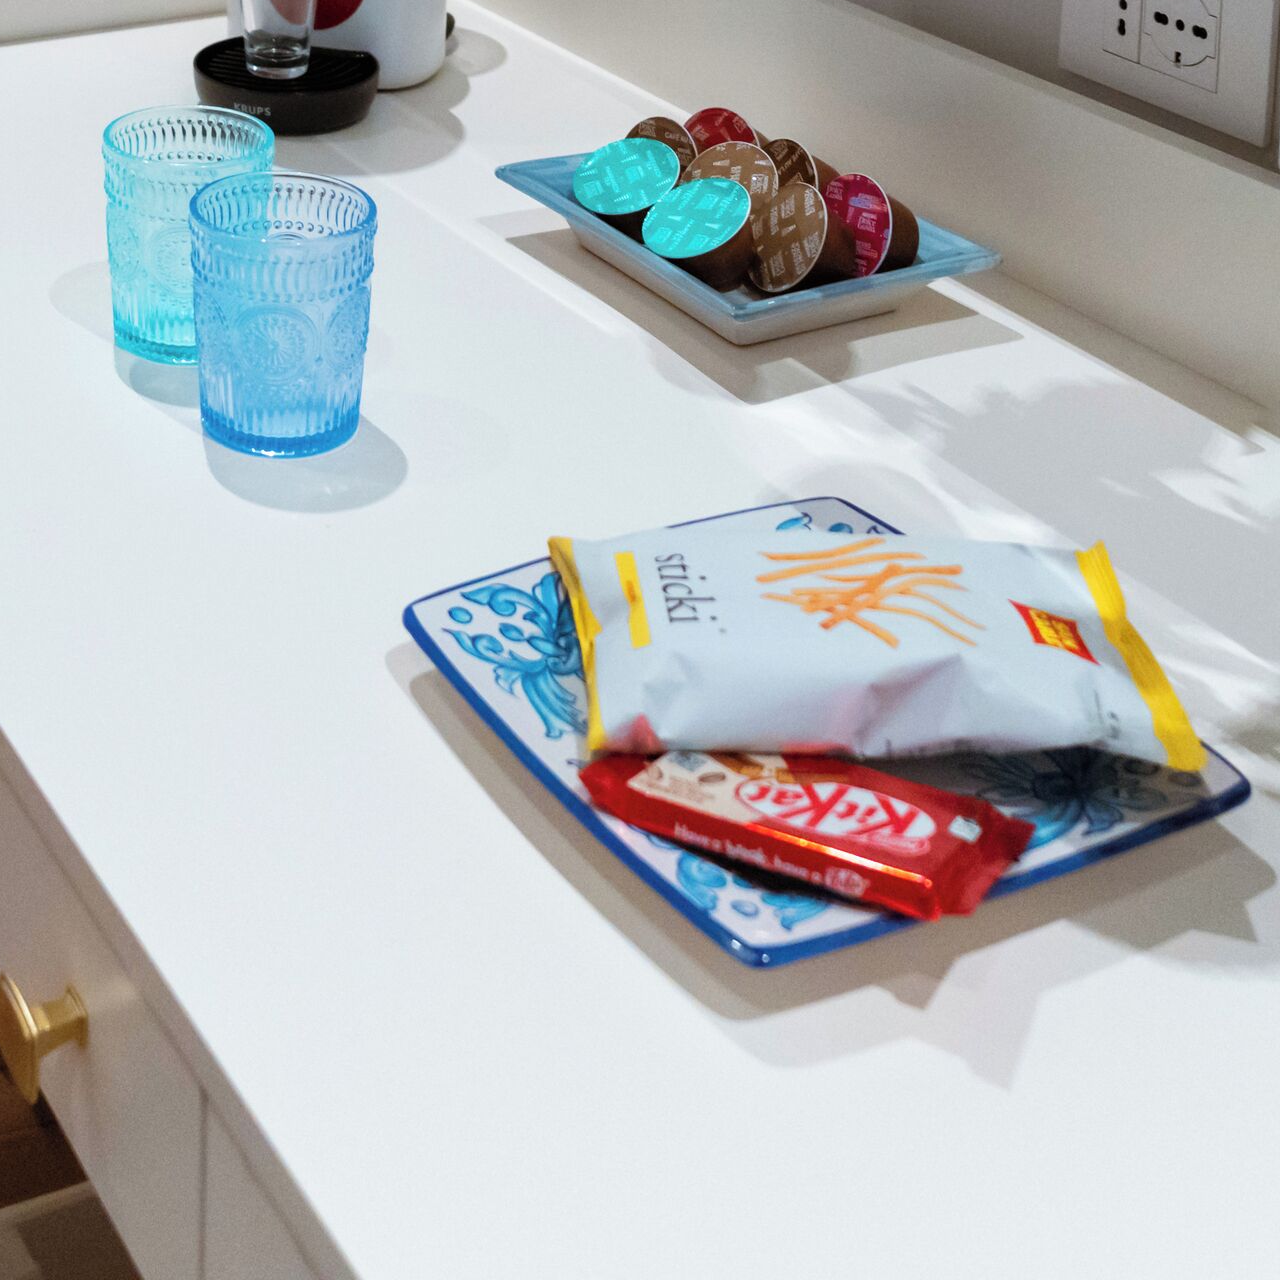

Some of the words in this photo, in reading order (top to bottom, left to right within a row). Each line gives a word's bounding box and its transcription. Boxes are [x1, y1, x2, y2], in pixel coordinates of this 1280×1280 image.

[233, 102, 271, 116] KRUPS
[654, 553, 718, 622] sticki
[748, 782, 922, 834] KitKat
